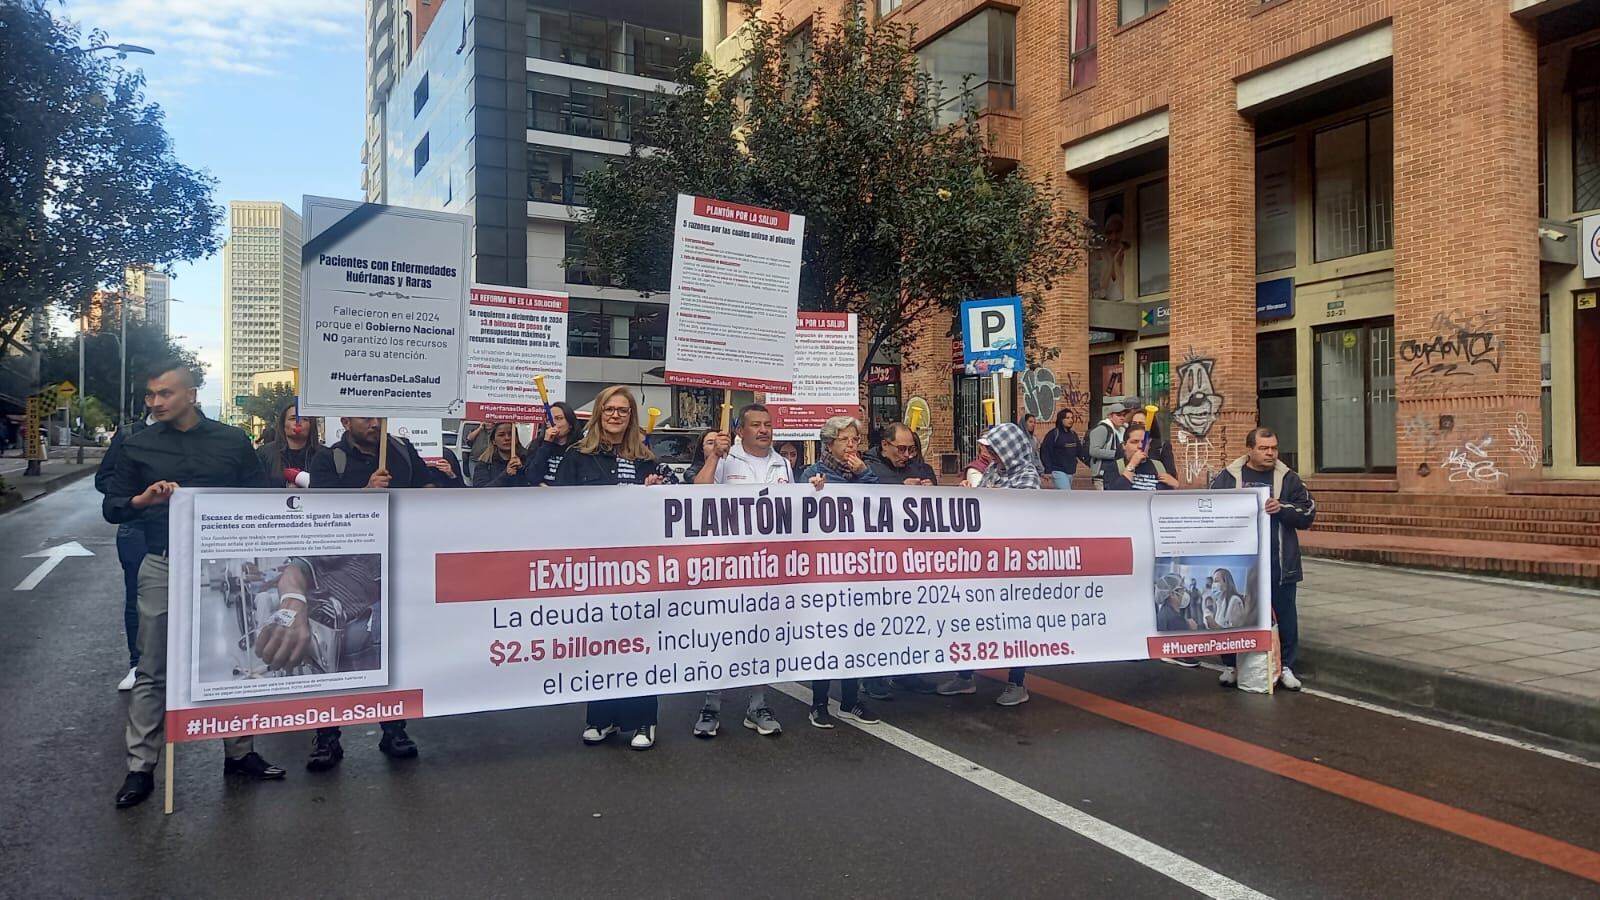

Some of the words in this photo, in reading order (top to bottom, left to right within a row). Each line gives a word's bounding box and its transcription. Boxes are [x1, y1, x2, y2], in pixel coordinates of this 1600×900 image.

[706, 204, 732, 218] PLANTÓN
[734, 208, 748, 220] POR
[750, 211, 756, 222] LA
[758, 212, 778, 226] SALUD
[688, 221, 711, 232] razones
[712, 225, 721, 234] por
[320, 254, 368, 270] Pacientes
[371, 260, 388, 272] con
[392, 261, 456, 278] Enfermedades
[346, 270, 395, 286] Huérfanas
[398, 276, 404, 288] y
[406, 276, 432, 288] Raras
[480, 294, 507, 304] REFORMA
[518, 297, 524, 306] ES
[526, 298, 533, 306] LA
[333, 306, 388, 318] Fallecieron
[405, 310, 414, 320] el
[416, 312, 440, 322] 2024
[316, 320, 352, 332] porque
[354, 321, 363, 330] el
[366, 322, 411, 333] Gobierno
[414, 326, 455, 336] Nacional
[818, 319, 825, 328] LA
[986, 310, 1011, 348] P
[323, 333, 338, 342] NO
[341, 335, 388, 347] garantizó
[390, 336, 404, 346] los
[406, 339, 448, 349] recursos
[344, 349, 367, 359] para
[369, 350, 381, 358] su
[383, 350, 428, 360] atención.
[330, 371, 441, 384] #HuérfanasDeLaSalud
[339, 388, 432, 399] #MuerenPacientes
[245, 513, 304, 521] medicamentos:
[306, 512, 331, 522] siguen
[344, 511, 370, 519] alertas
[664, 488, 792, 538] PLANTÓN
[802, 496, 856, 534] POR
[863, 497, 894, 534] LA
[903, 497, 981, 534] SALUD
[201, 522, 240, 532] pacientes
[257, 521, 312, 529] enfermedades
[313, 520, 351, 528] huérfanas
[529, 555, 650, 592] ¡Exigimos
[657, 555, 679, 584] la
[686, 548, 778, 586] garantía
[785, 550, 810, 577] de
[816, 548, 898, 574] nuestro
[902, 547, 982, 575] derecho
[986, 552, 997, 572] a
[1004, 547, 1022, 572] la
[1026, 546, 1082, 571] salud!
[493, 607, 522, 629] La
[530, 602, 603, 626] deuda
[610, 598, 661, 621] total
[667, 592, 780, 617] acumulada
[785, 594, 795, 609] a
[800, 587, 912, 614] septiembre
[917, 585, 960, 604] 2024
[965, 588, 995, 602] son
[1000, 583, 1080, 601] alrededor
[1084, 582, 1104, 599] de
[489, 639, 545, 666] $2.5
[552, 636, 651, 660] billones,
[658, 624, 770, 652] incluyendo
[775, 620, 848, 643] ajustes
[854, 619, 876, 636] de
[880, 617, 931, 638] 2022,
[936, 620, 946, 638] y
[950, 619, 972, 633] se
[976, 614, 1032, 632] estima
[1036, 614, 1067, 633] que
[1071, 612, 1107, 632] para
[1162, 637, 1257, 654] #MuerenPacientes
[543, 674, 562, 695] el
[570, 668, 638, 693] cierre
[645, 663, 677, 687] del
[683, 660, 723, 682] año
[728, 657, 770, 678] esta
[776, 650, 839, 678] pueda
[844, 648, 930, 669] ascender
[934, 649, 944, 664] a
[949, 642, 999, 664] $3.82
[1003, 639, 1076, 660] billones.
[186, 700, 404, 736] #HuérfanasDeLaSalud
